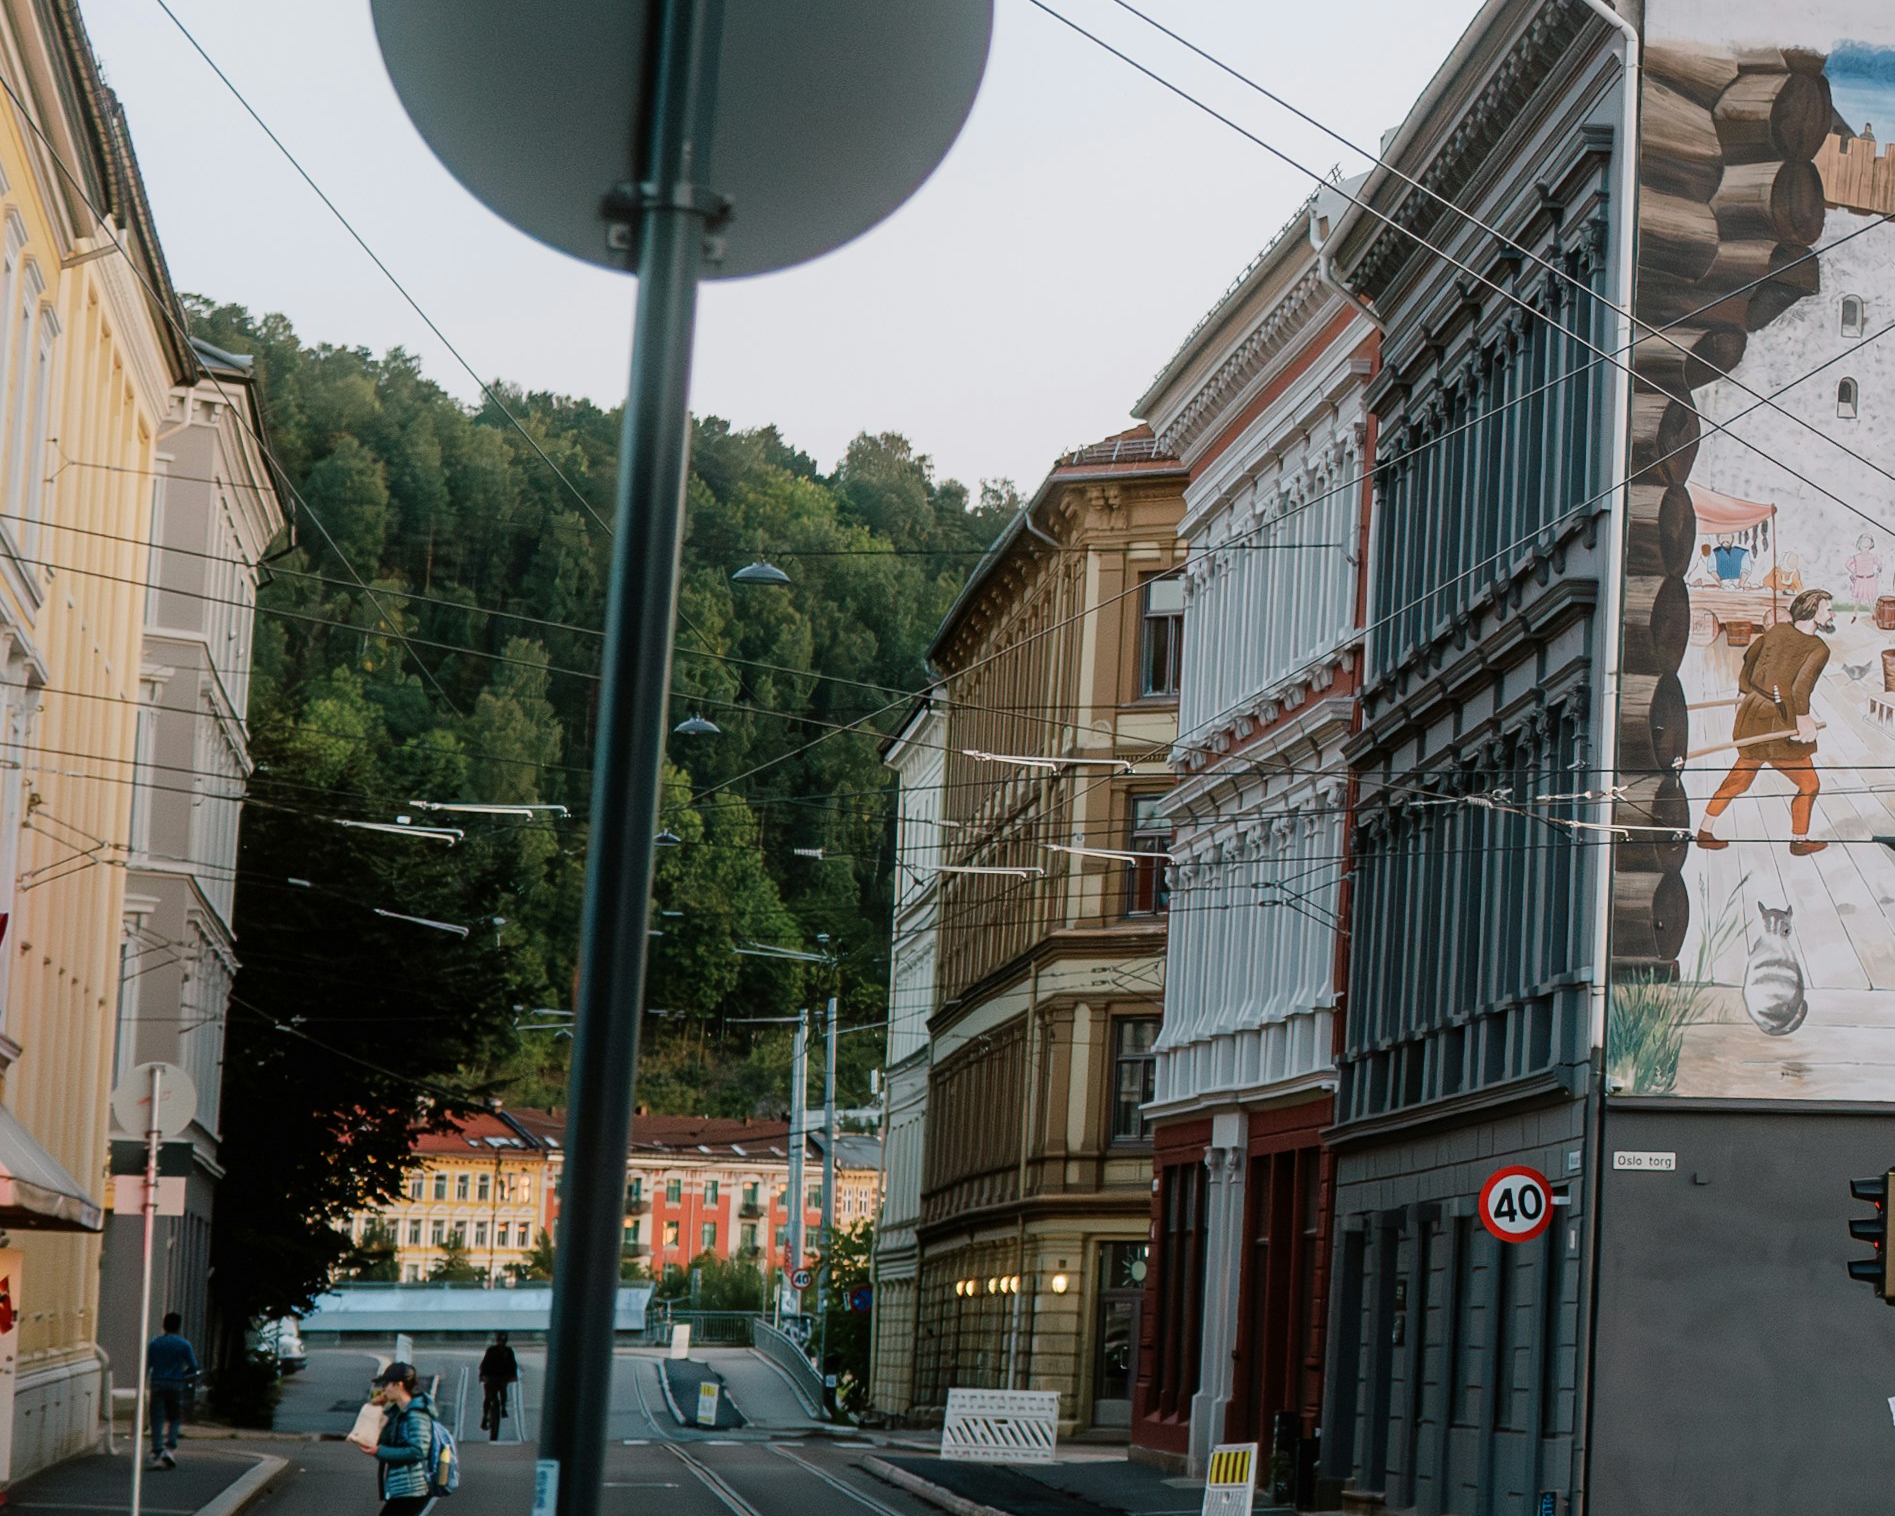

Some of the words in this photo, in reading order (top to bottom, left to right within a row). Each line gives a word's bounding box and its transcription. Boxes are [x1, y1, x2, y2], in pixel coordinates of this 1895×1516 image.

[1617, 1155, 1643, 1166] Oslo
[1649, 1155, 1672, 1169] torg
[1494, 1184, 1543, 1223] 40
[795, 1274, 810, 1285] 40
